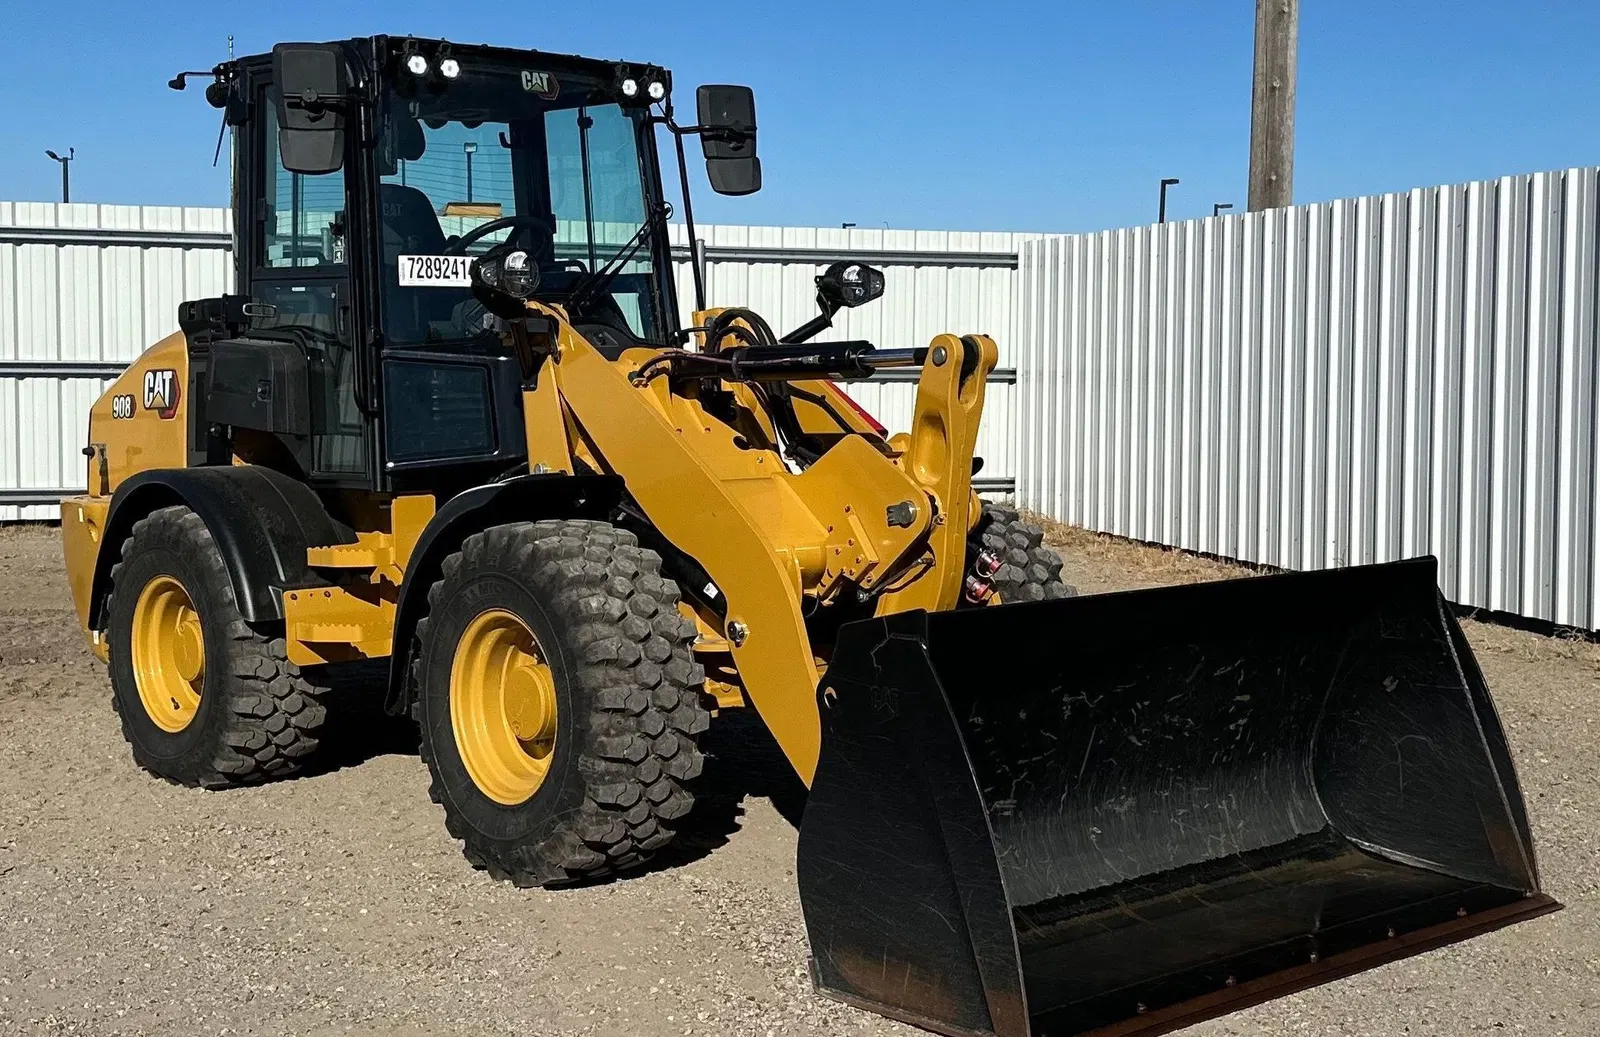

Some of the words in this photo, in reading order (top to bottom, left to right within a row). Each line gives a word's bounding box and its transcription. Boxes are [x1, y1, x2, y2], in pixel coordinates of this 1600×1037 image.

[521, 71, 549, 93] CAT
[407, 257, 474, 280] 7289241
[144, 371, 173, 408] CAT
[113, 396, 132, 418] 908
